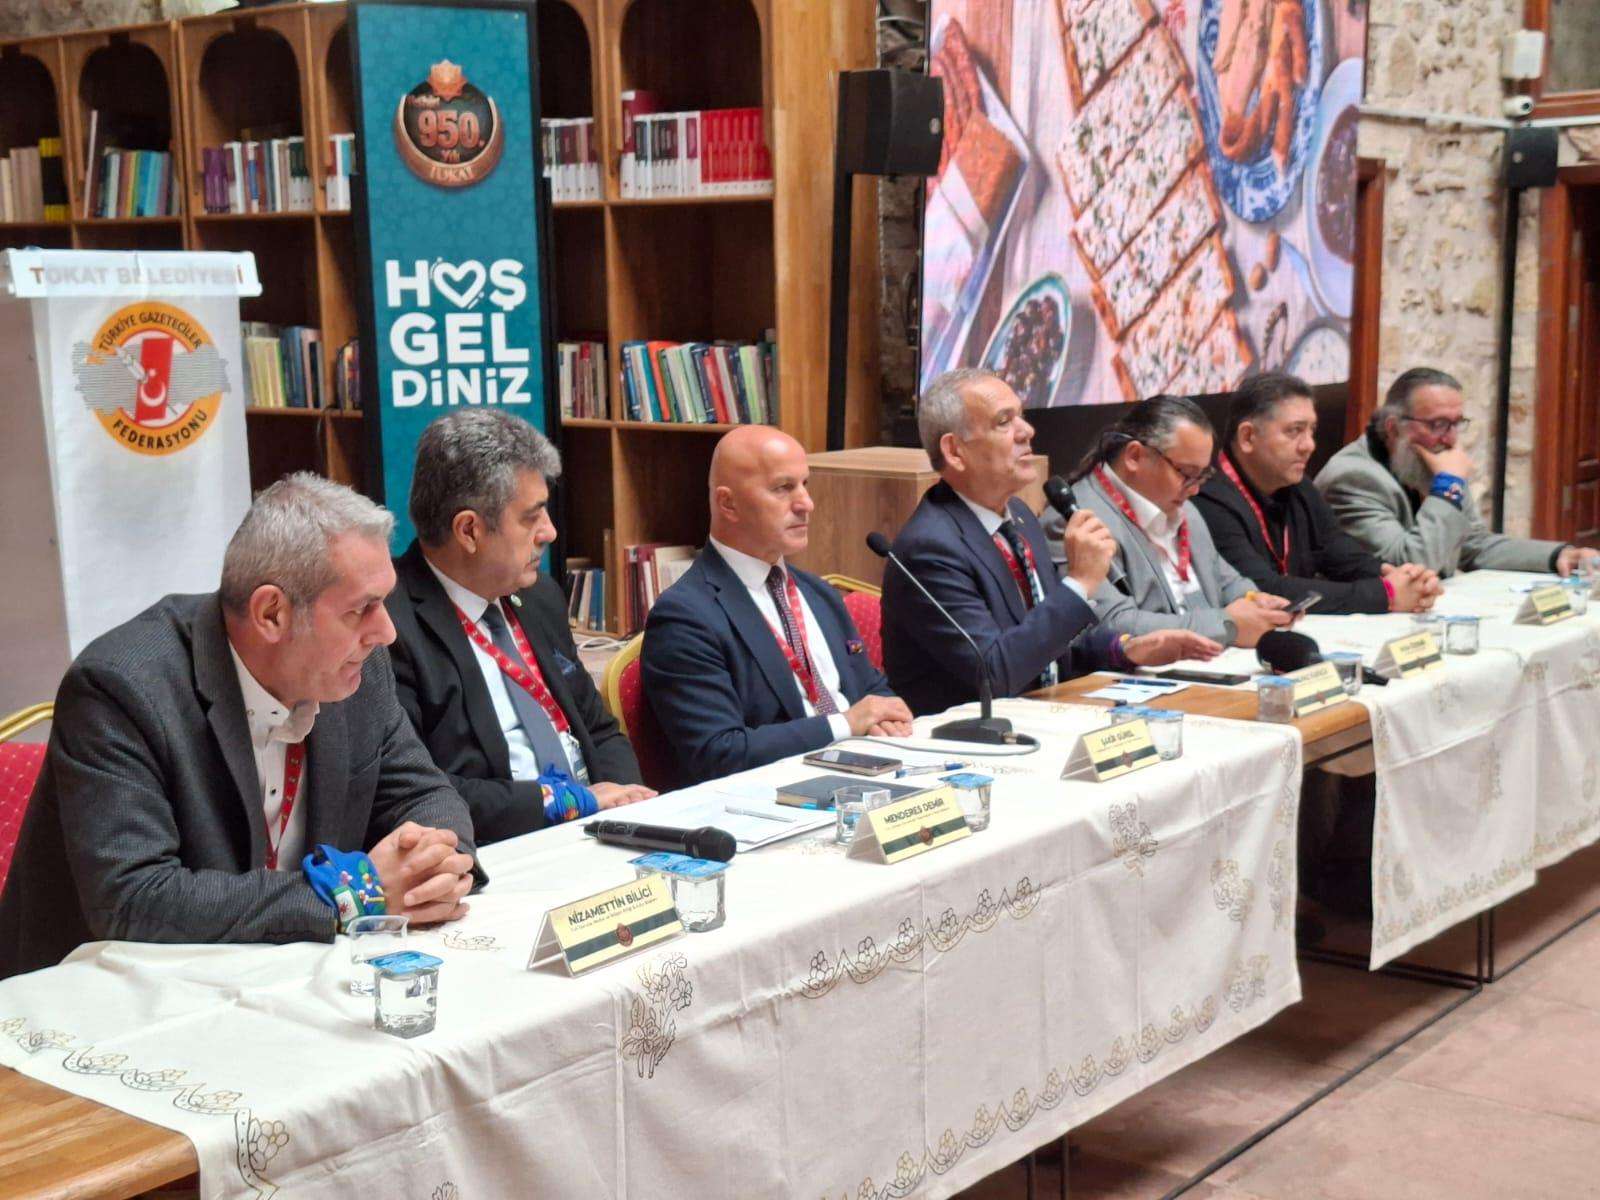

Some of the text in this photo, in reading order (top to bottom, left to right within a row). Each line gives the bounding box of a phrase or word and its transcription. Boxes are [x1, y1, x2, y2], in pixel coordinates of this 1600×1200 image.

[29, 267, 107, 285] TOKAT
[99, 311, 203, 351] TÜRKİYE GAZETECİLER
[389, 312, 530, 365] GEL
[112, 409, 208, 450] FEDERASYONU
[884, 805, 923, 823] MENDERES
[923, 797, 944, 811] DEMİR
[568, 895, 625, 926] NİZAMETTİN
[626, 886, 653, 904] BİLİCİ
